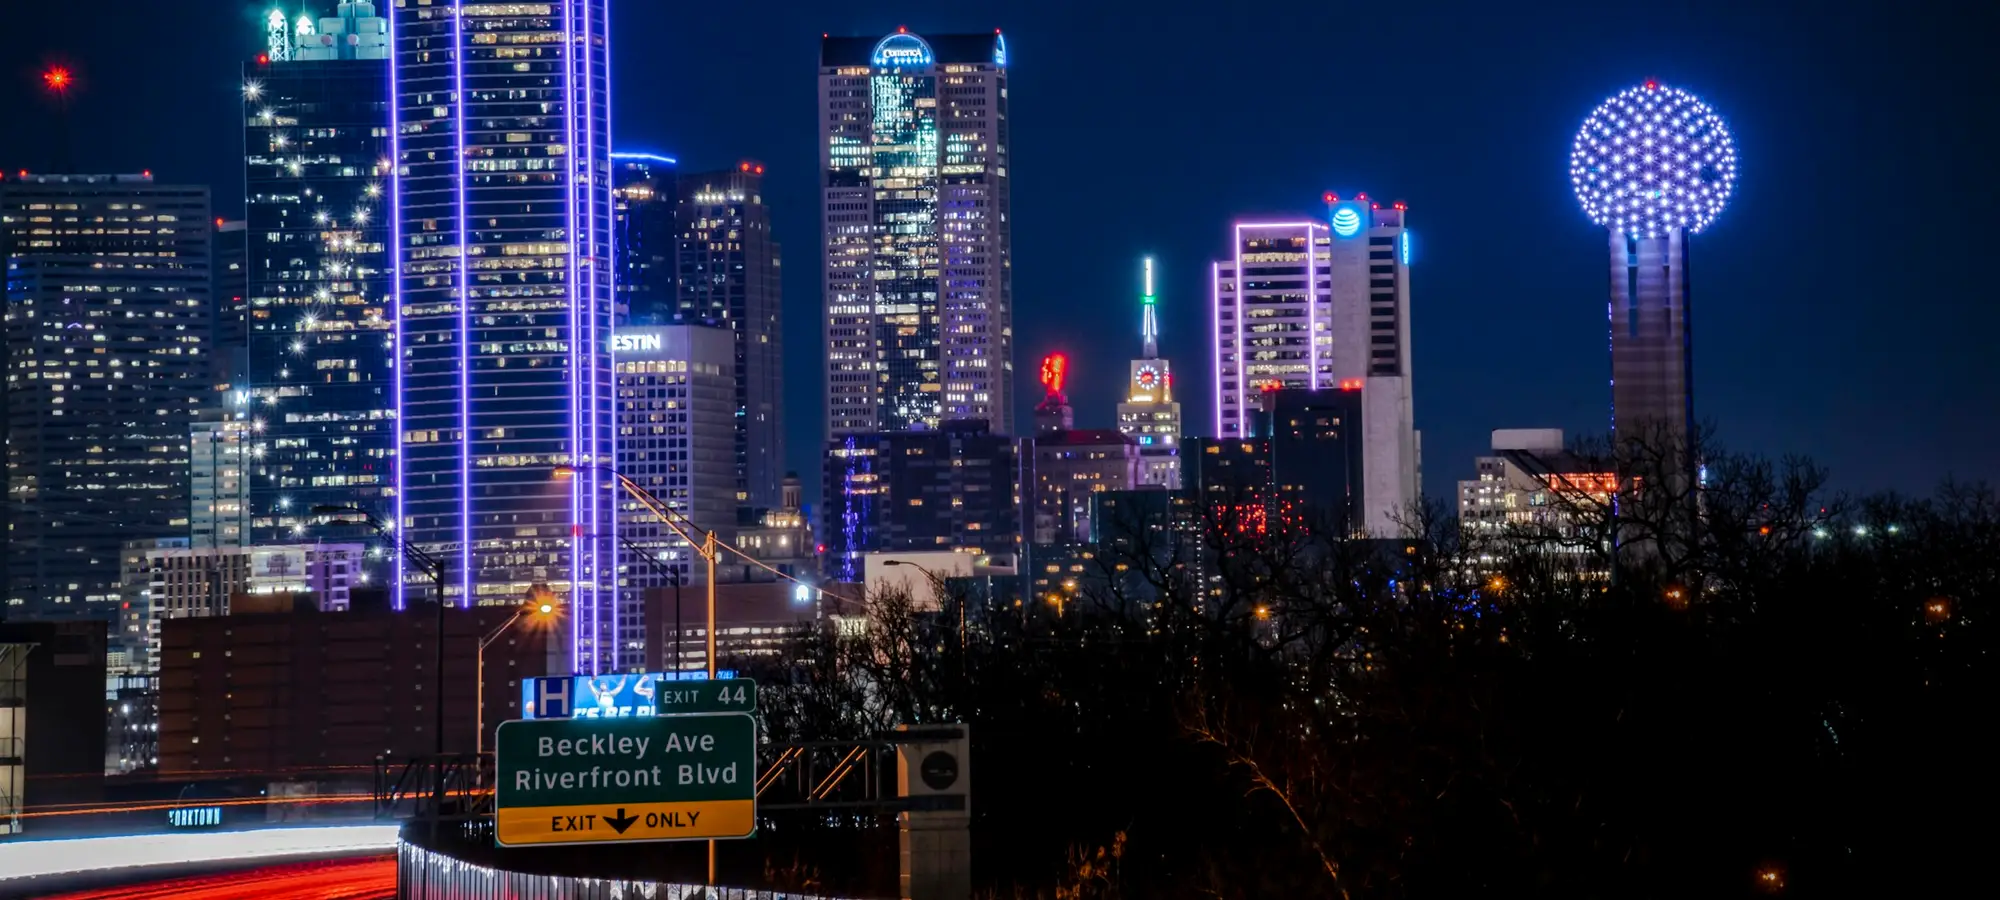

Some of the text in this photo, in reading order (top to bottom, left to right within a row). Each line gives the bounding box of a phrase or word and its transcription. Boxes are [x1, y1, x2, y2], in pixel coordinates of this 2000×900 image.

[612, 335, 661, 350] ESTIN
[540, 679, 569, 716] H
[664, 686, 747, 705] EXIT 44
[538, 732, 715, 760] Beckley Ave
[515, 762, 738, 791] Riverfront Blvd
[168, 807, 220, 827] YORKTOWN
[552, 811, 700, 832] EXIT ONLY
